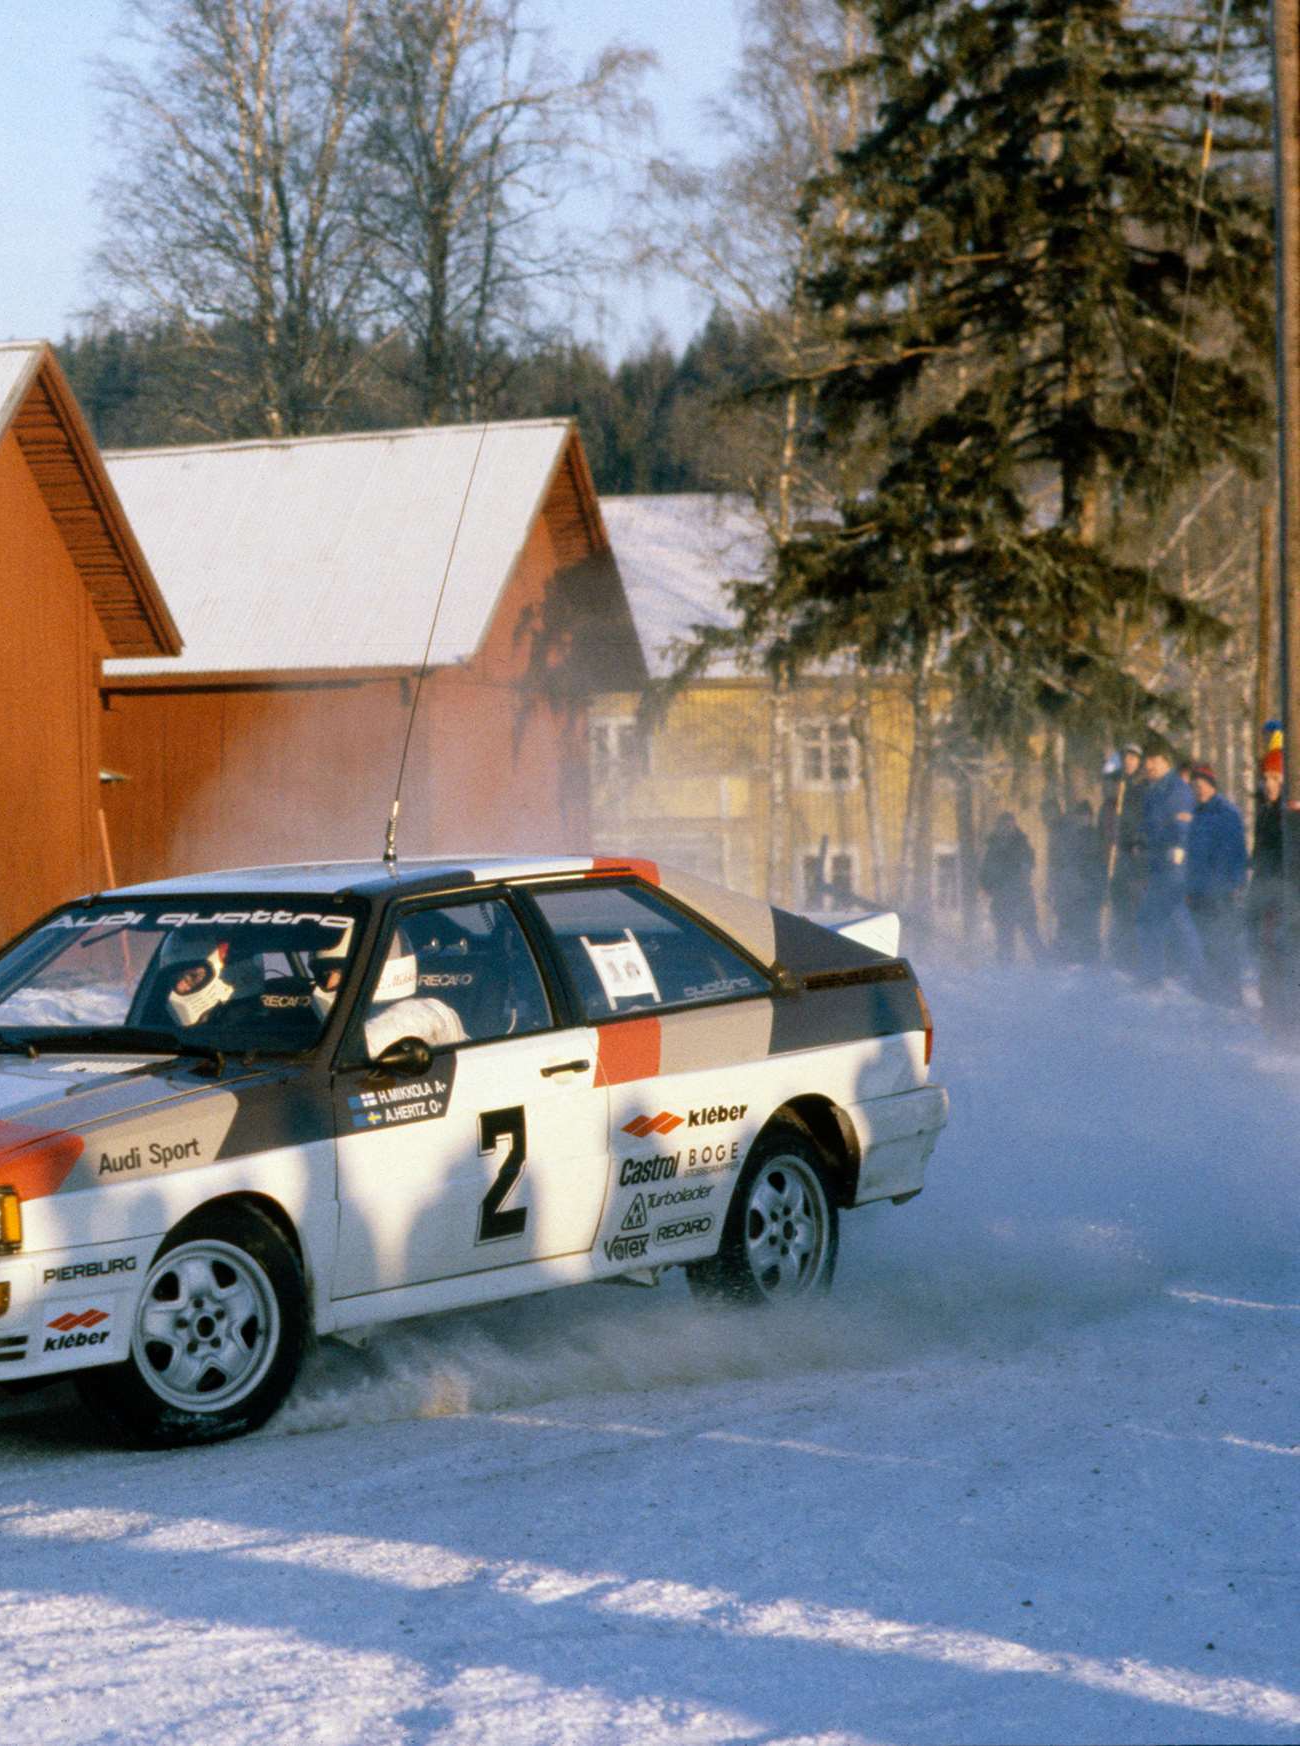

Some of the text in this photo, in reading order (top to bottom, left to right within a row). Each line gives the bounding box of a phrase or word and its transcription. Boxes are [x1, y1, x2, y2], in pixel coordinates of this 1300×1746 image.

[46, 908, 355, 929] Audi quattro
[377, 1083, 434, 1105] H.MIKKOLA
[385, 1102, 428, 1123] A.HERTZ
[99, 1138, 201, 1175] Audi Sport
[688, 1142, 739, 1167] BOGE
[474, 1104, 528, 1247] 2
[619, 1151, 681, 1187] Castrol
[647, 1184, 715, 1209] Turbolader
[657, 1217, 712, 1241] RECARO
[43, 1256, 137, 1285] PIERBURG
